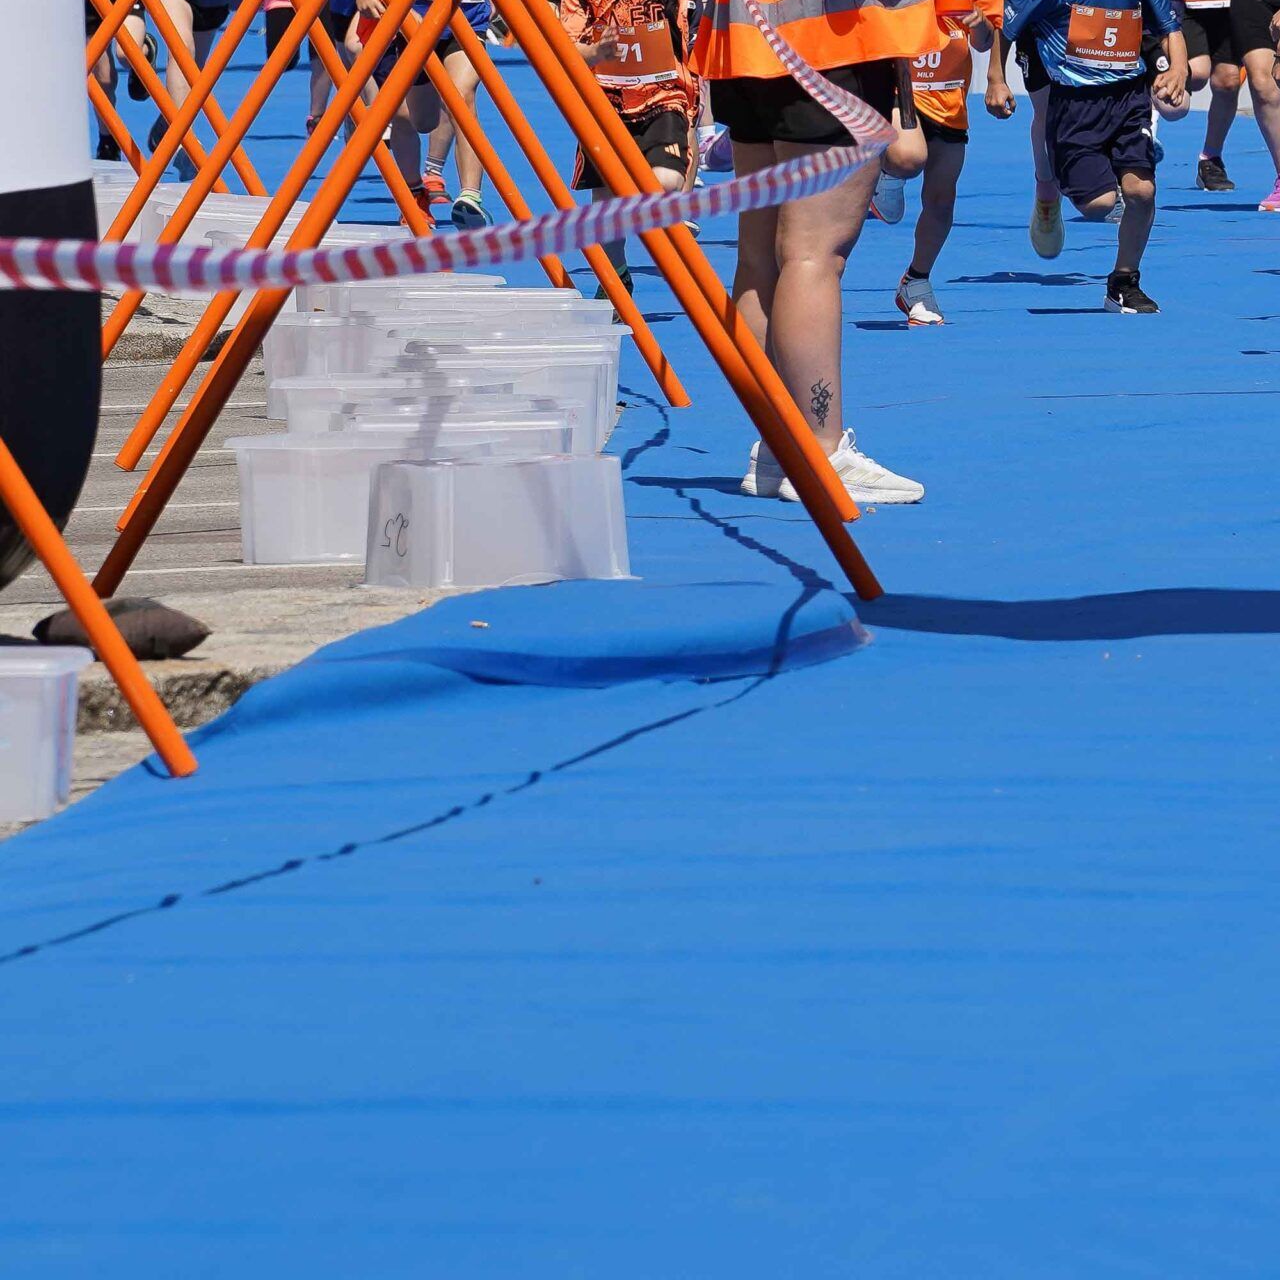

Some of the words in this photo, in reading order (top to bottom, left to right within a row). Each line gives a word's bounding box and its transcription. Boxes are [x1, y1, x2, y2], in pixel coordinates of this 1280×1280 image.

[1103, 27, 1118, 48] 5
[616, 42, 643, 63] 71
[1075, 47, 1136, 58] MUHAMMED-HAMZA
